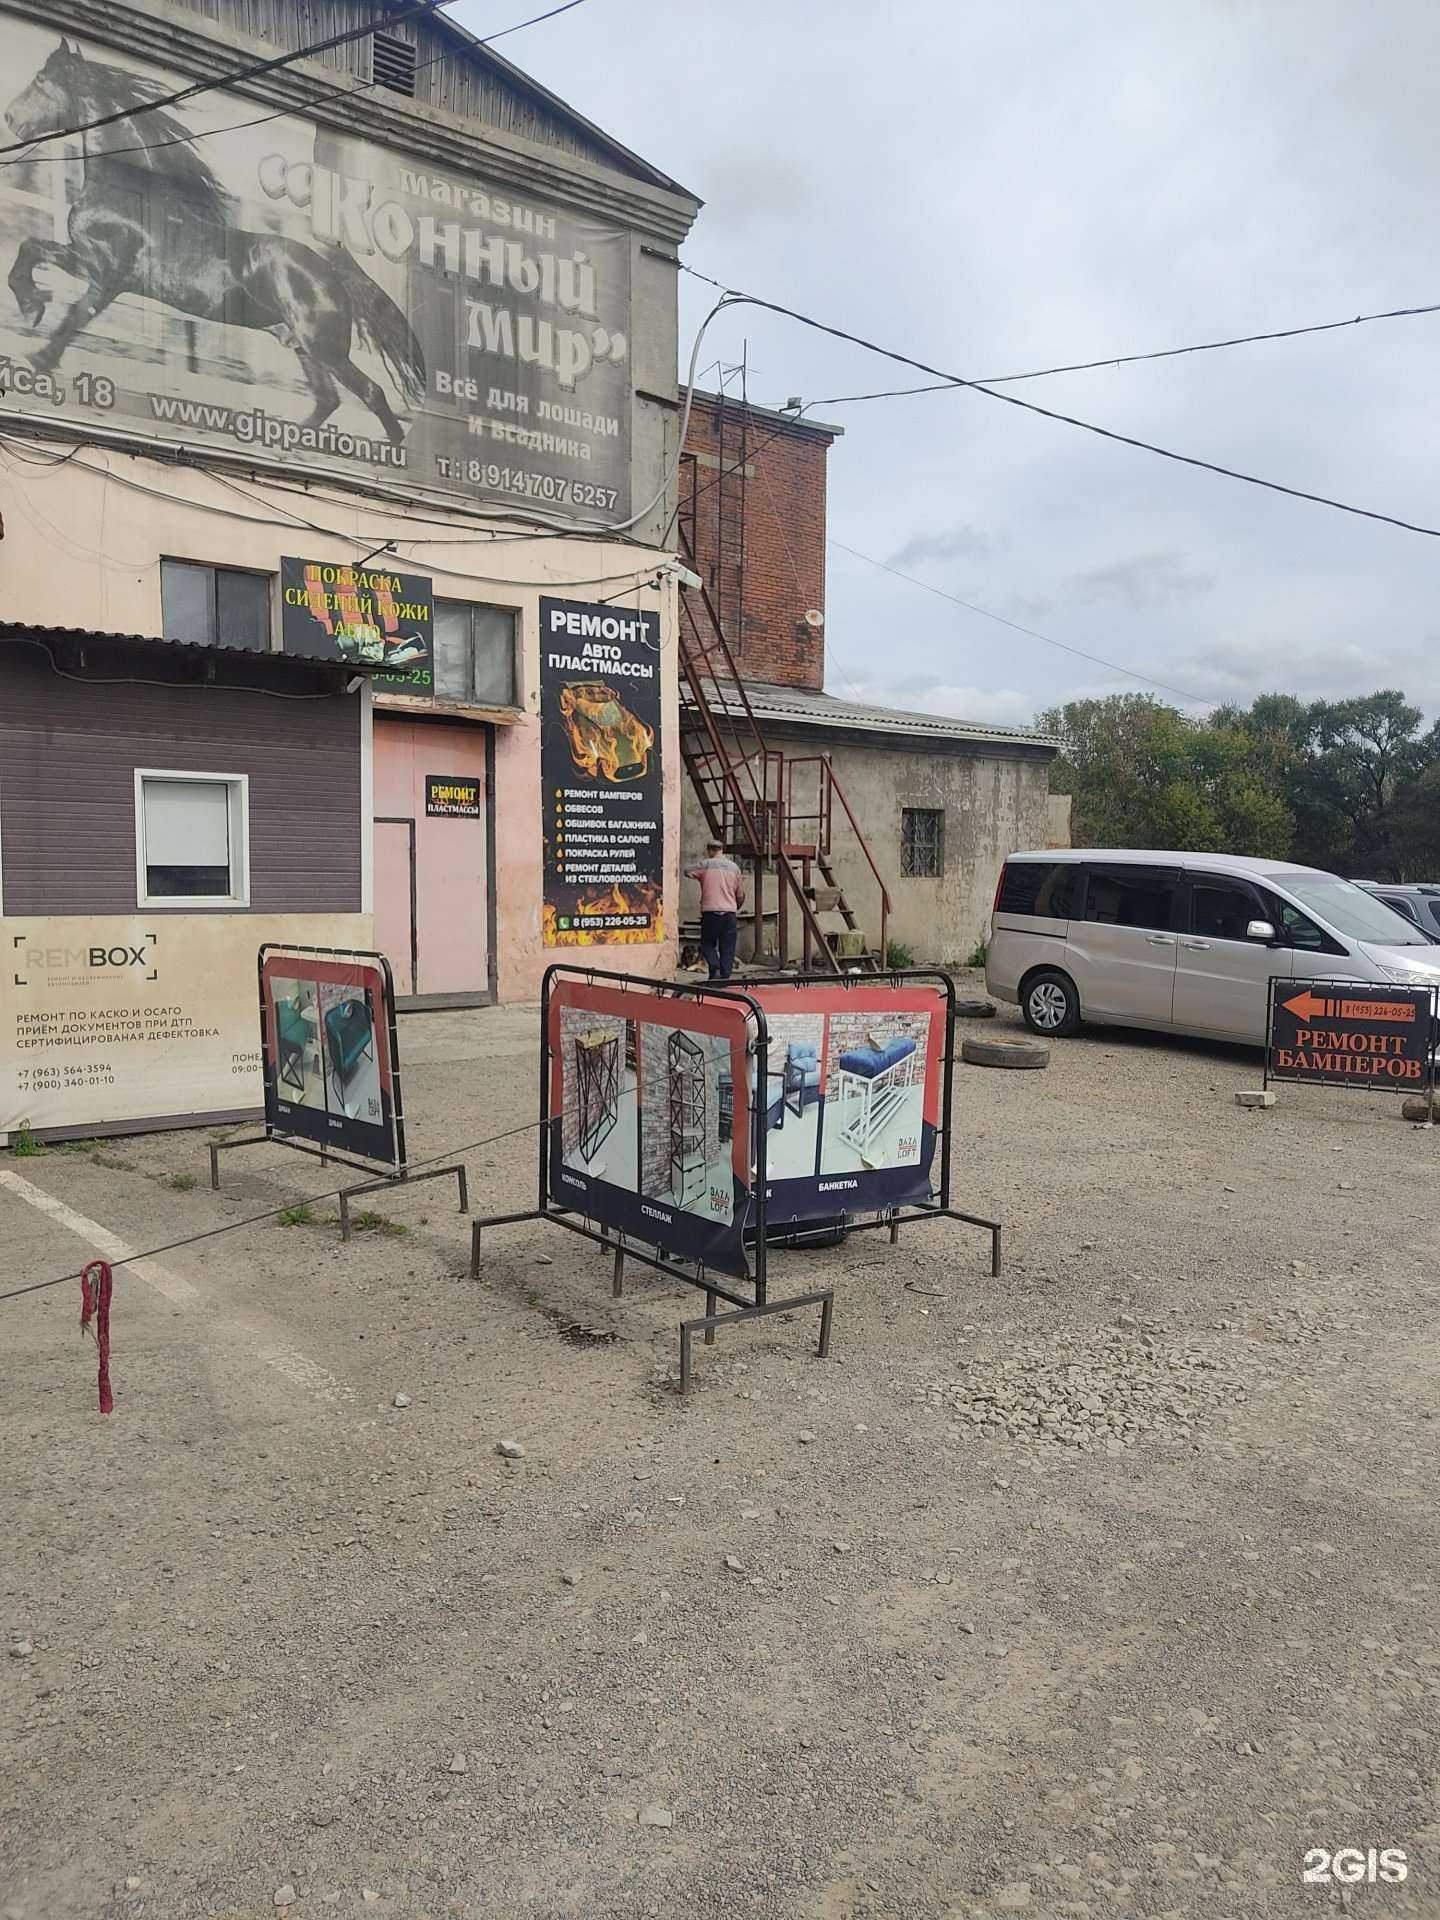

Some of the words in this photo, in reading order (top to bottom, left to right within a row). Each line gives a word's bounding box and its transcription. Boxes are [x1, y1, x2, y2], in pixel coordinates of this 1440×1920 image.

[400, 168, 557, 240] магазин
[75, 374, 114, 408] 18
[435, 370, 478, 401] Всё
[487, 386, 529, 414] для
[537, 401, 619, 437] лошади
[151, 396, 407, 467] www.gipparion.ru
[491, 421, 592, 461] всадника
[468, 460, 481, 482] 8
[487, 463, 525, 491] 914
[531, 473, 566, 499] 707
[572, 482, 618, 510] 5257
[310, 565, 403, 593] ПОКРАСКА
[285, 588, 372, 615] СИДЕНИЙ
[377, 601, 429, 621] КОЖИ
[550, 609, 650, 643] РЕМОНТ
[582, 642, 622, 660] АВТО
[548, 653, 653, 678] ПЛАСТМАССЫ
[431, 785, 477, 801] РЕМОНТ
[564, 789, 598, 799] РЕМОНТ
[599, 790, 643, 801] БАМПЕРОВ
[564, 804, 603, 814] ОБВЕСОВ
[565, 819, 607, 829] ОБШИВОК
[608, 820, 657, 830] БАГАЖНИКА
[565, 834, 609, 844] ПЛАСТИКА
[610, 835, 616, 843] В
[617, 835, 650, 844] САЛОНЕ
[565, 849, 608, 858] ПОКРАСКА
[610, 848, 636, 858] РУЛЕЙ
[565, 864, 599, 873] РЕМОНТ
[600, 863, 636, 873] ДЕТАЛЕЙ
[565, 875, 577, 883] ИЗ
[578, 875, 648, 883] СТЕКЛОВОЛОКНА
[573, 918, 579, 927] 8
[581, 917, 603, 928] (953)
[605, 916, 647, 926] 226-05-25
[26, 946, 146, 968] REMBOX
[16, 1012, 65, 1023] РЕМОНТ
[69, 1011, 86, 1021] ПО
[90, 1009, 129, 1020] КАСКО
[132, 1009, 140, 1017] И
[144, 1006, 182, 1016] ОСАГО
[16, 1024, 58, 1036] ПРИЁМ
[61, 1020, 142, 1034] ДОКУМЕНТОВ
[145, 1019, 167, 1029] ПРИ
[170, 1017, 193, 1028] ДТП
[16, 1032, 145, 1049] СЕРТИФИЦИРОВАНАЯ
[147, 1028, 220, 1041] ДЕФЕКТОВКА
[1295, 1029, 1408, 1055] РЕМОНТ
[232, 1053, 263, 1062] ПОНЕ
[1277, 1050, 1422, 1078] БАМПЕРОВ
[17, 1069, 29, 1078] +7
[32, 1066, 61, 1079] (963)
[63, 1064, 112, 1076] 564-3594
[17, 1082, 29, 1091] +7
[32, 1079, 61, 1092] (900)
[63, 1075, 115, 1088] 340-01-10
[818, 1179, 858, 1192] БАНКЕТКА
[640, 1204, 673, 1224] СТЕЛЛАЖ
